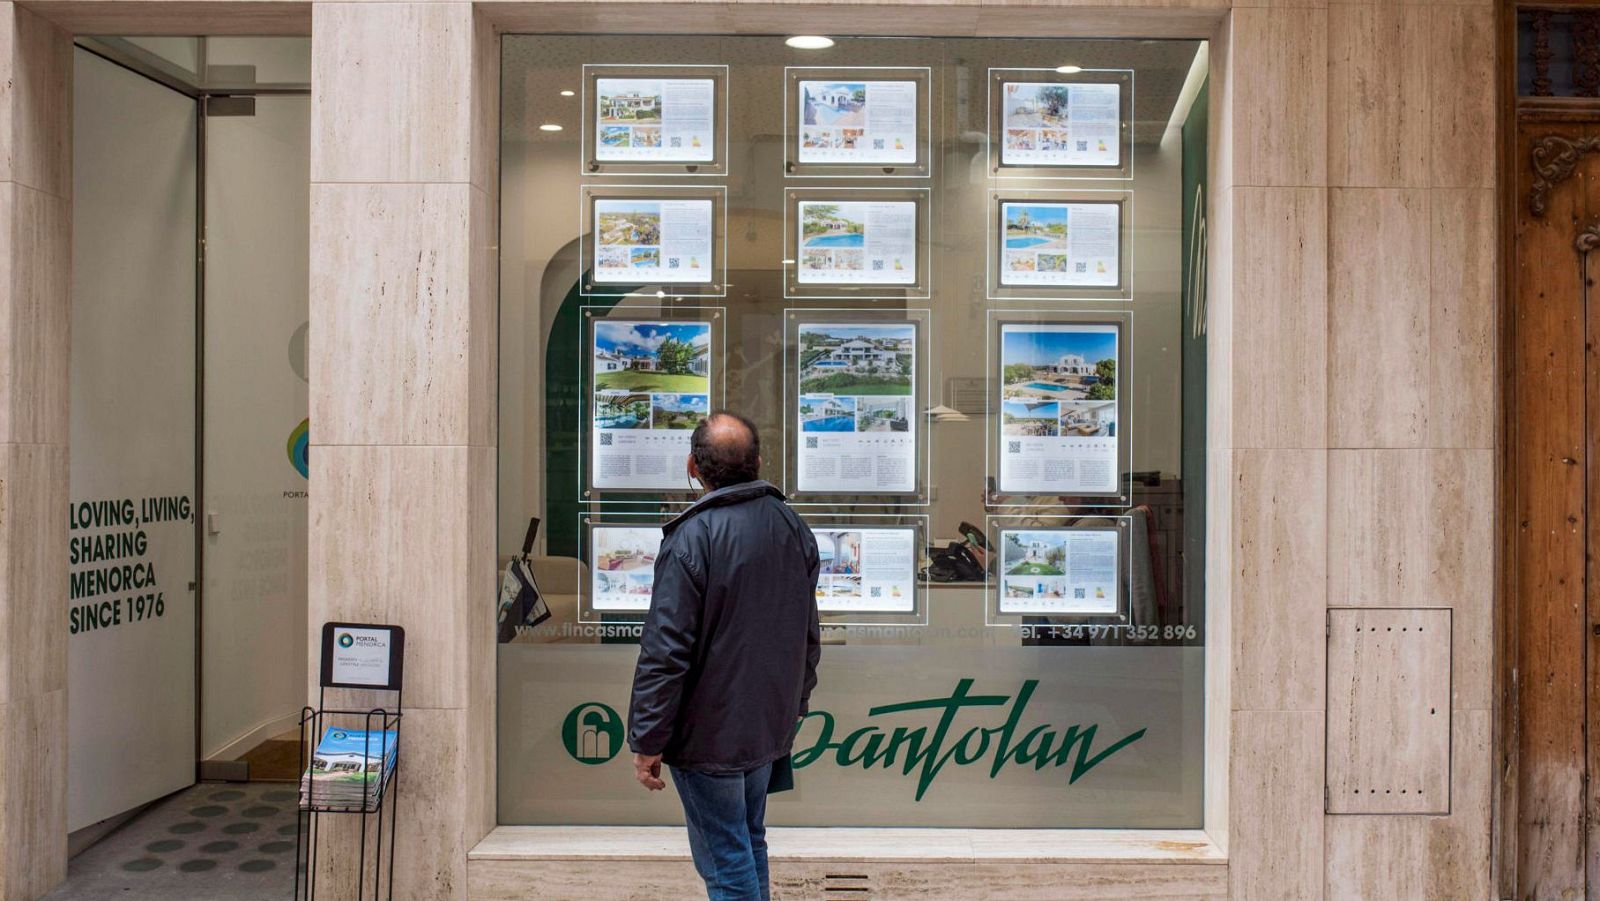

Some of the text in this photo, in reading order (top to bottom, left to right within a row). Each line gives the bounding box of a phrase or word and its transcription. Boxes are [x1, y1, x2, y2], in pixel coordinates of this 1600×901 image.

[70, 496, 195, 530] LOVING, LIVING,
[70, 531, 147, 565] SHARING
[70, 562, 156, 600] MENORCA
[70, 592, 165, 635] SINCE 1976
[1048, 625, 1084, 640] +34
[1088, 625, 1120, 640] 971
[1126, 625, 1160, 640] 352
[1164, 625, 1197, 640] 896
